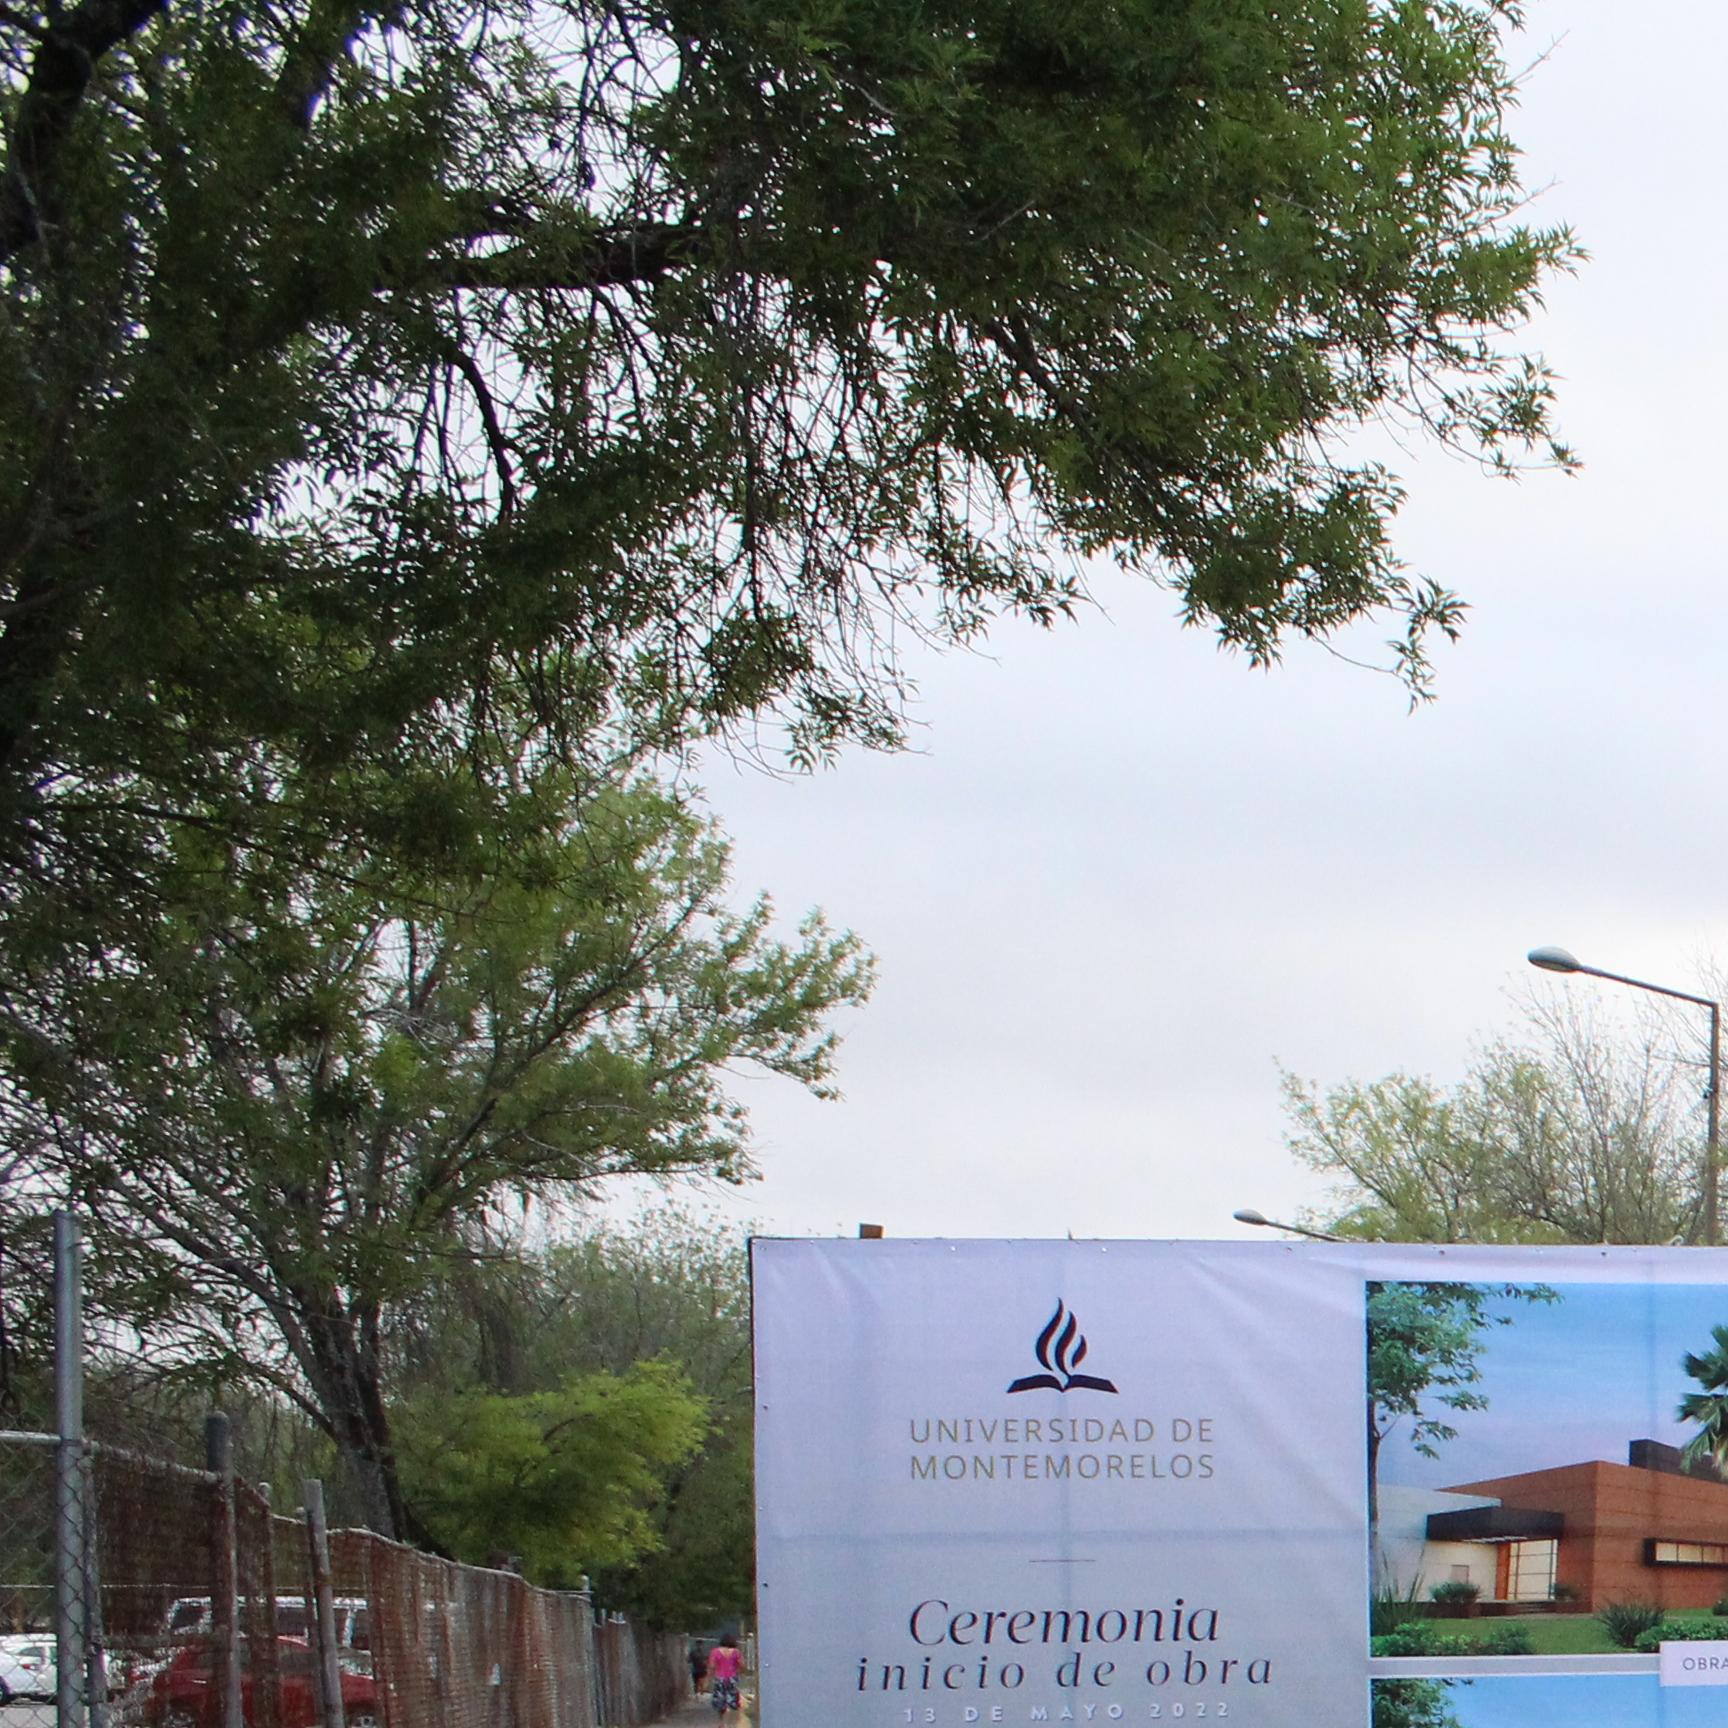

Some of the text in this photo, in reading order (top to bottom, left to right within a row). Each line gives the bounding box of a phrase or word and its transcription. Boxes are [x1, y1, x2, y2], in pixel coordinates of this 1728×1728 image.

[910, 1418, 1214, 1444] UNIVERSIDAD DE
[910, 1453, 1215, 1480] MONTEMORELOS
[909, 1598, 1220, 1646] Ceremonia
[857, 1649, 1272, 1692] inicio de obra
[903, 1701, 1230, 1724] 13 DE MAYO 2022
